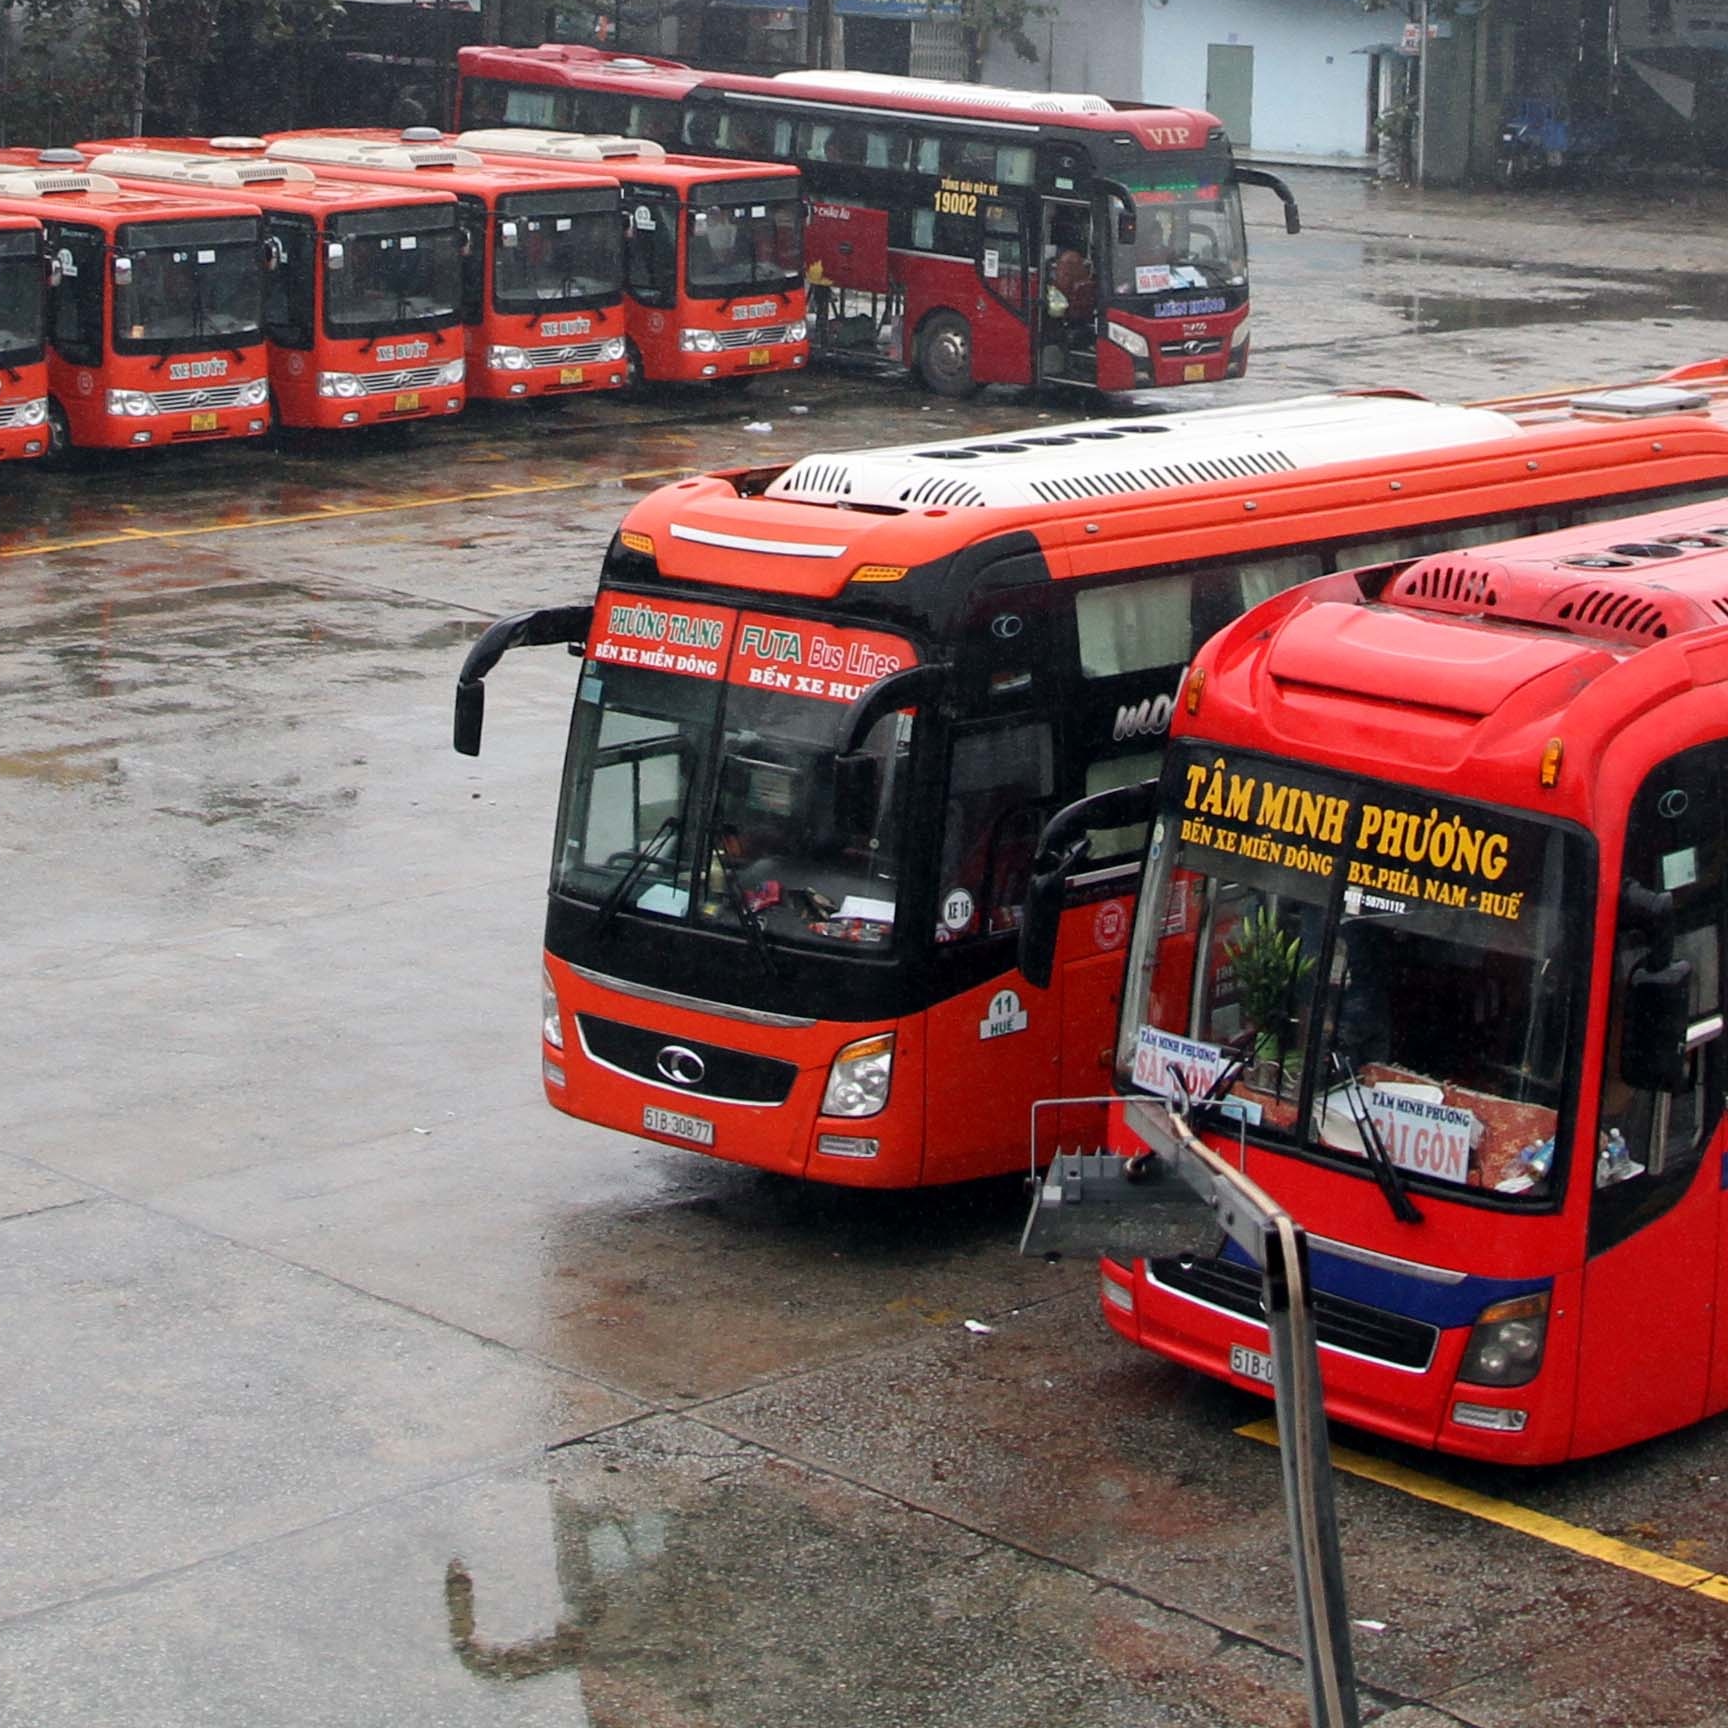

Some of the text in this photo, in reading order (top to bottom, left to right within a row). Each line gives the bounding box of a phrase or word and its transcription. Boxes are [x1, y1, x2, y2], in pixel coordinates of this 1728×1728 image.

[1146, 127, 1190, 145] VIP
[934, 190, 977, 217] 19002
[609, 601, 724, 649] PHƯƠNG TRANG
[595, 639, 718, 676] BẾN XE MIỀN ĐÔNG
[740, 626, 901, 677] FUTA Bus Lines
[749, 664, 790, 687] BẾN
[794, 677, 824, 694] XE
[1184, 757, 1509, 881] TÂM MINH PHƯƠNG
[1181, 818, 1334, 876] BẾN XE MIỀN ĐÔNG
[946, 902, 959, 920] XE
[1423, 877, 1469, 910] NAM
[1479, 888, 1524, 921] HUẾ
[994, 996, 1013, 1014] 11
[1372, 1088, 1470, 1128] TÂM MINH PHƯƠNG
[1414, 1125, 1466, 1175] GÒN
